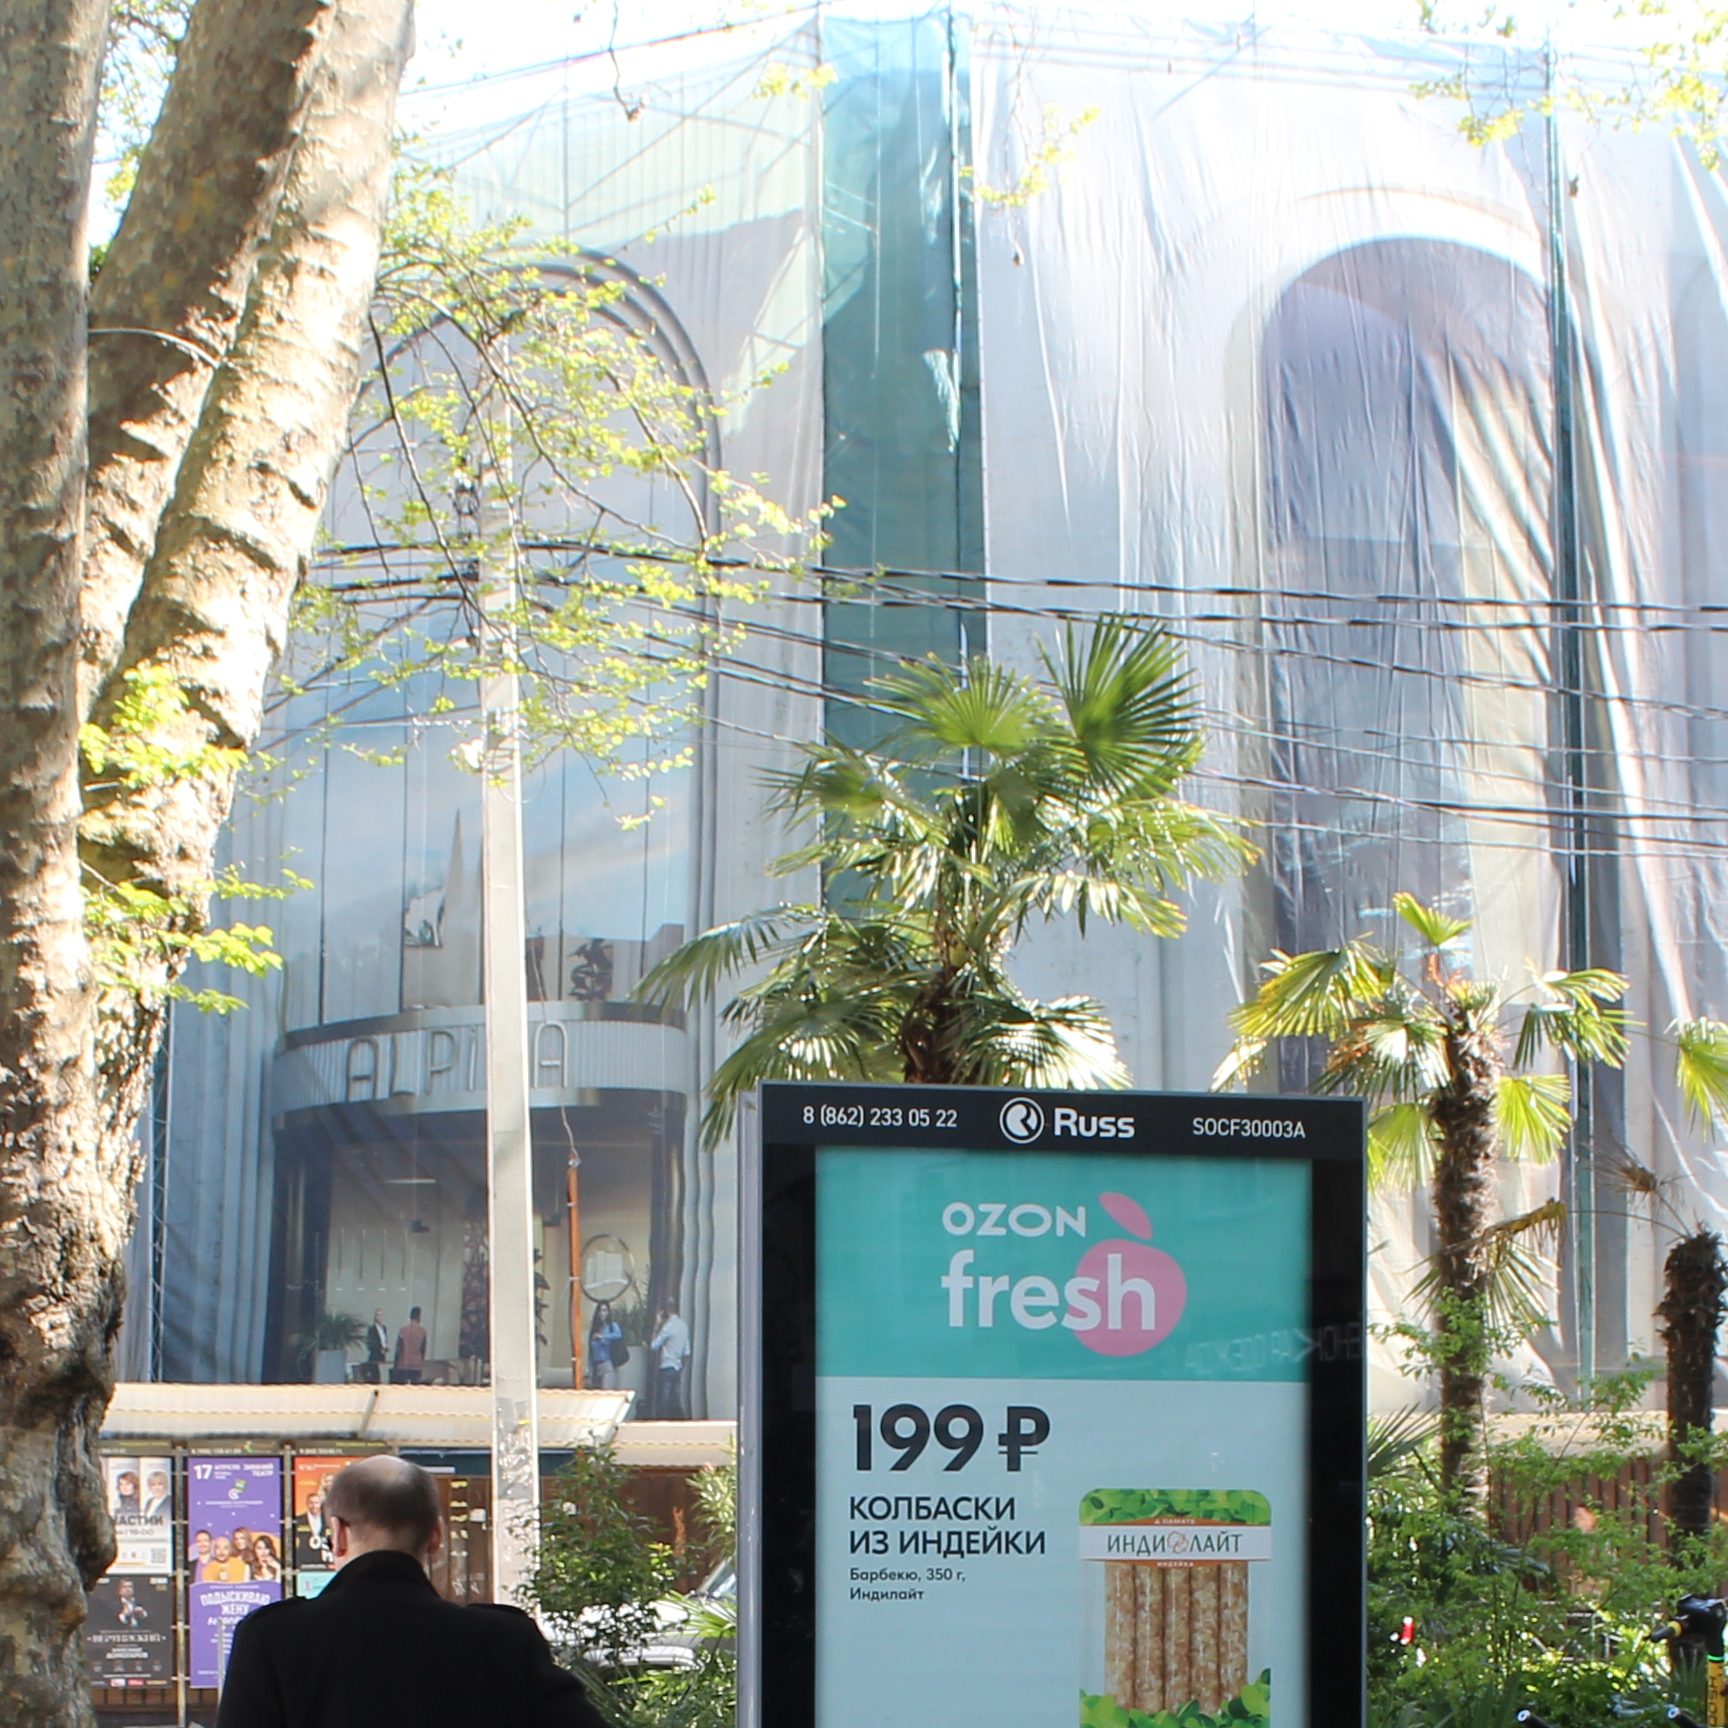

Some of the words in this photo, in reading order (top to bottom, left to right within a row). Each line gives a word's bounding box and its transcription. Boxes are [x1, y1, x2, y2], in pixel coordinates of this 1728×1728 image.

[803, 1105, 815, 1125] 8
[820, 1104, 865, 1128] (862)
[870, 1107, 903, 1127] 233
[908, 1108, 931, 1128] 05
[935, 1109, 959, 1128] 22
[1054, 1107, 1136, 1139] Russ
[1192, 1117, 1306, 1139] SOCF30003A
[941, 1201, 1087, 1238] OZON
[941, 1248, 1157, 1331] fresh
[853, 1403, 984, 1472] 199
[193, 1463, 214, 1480] 17
[849, 1496, 1016, 1521] КОЛБАСКИ
[849, 1530, 890, 1555] ИЗ
[898, 1525, 1046, 1560] ИНДЕЙКИ
[849, 1567, 922, 1584] Барбекю,
[925, 1568, 953, 1581] 350
[849, 1587, 925, 1602] Индилайт
